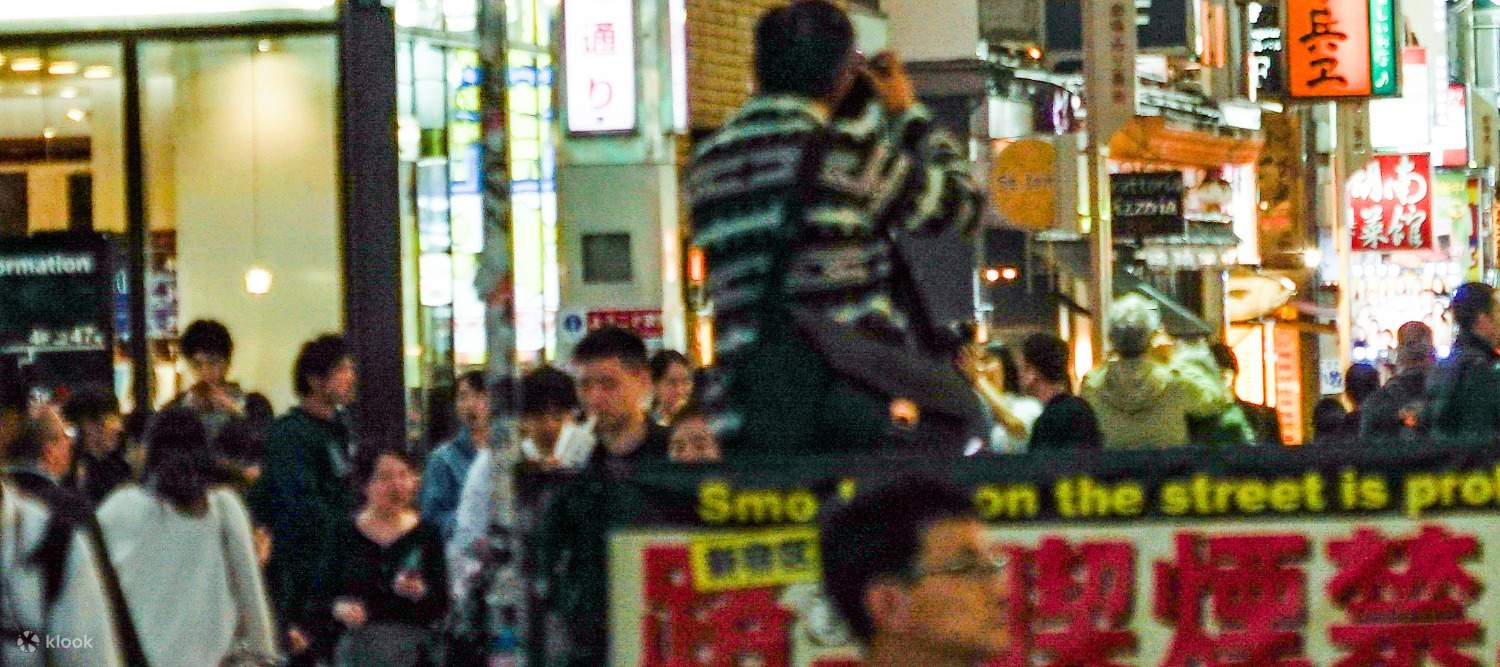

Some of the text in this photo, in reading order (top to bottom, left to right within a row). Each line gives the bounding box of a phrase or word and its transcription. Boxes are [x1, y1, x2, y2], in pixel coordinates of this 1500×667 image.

[976, 483, 1039, 518] on
[1053, 474, 1145, 517] the
[1160, 470, 1325, 516] street
[1340, 465, 1389, 510] is
